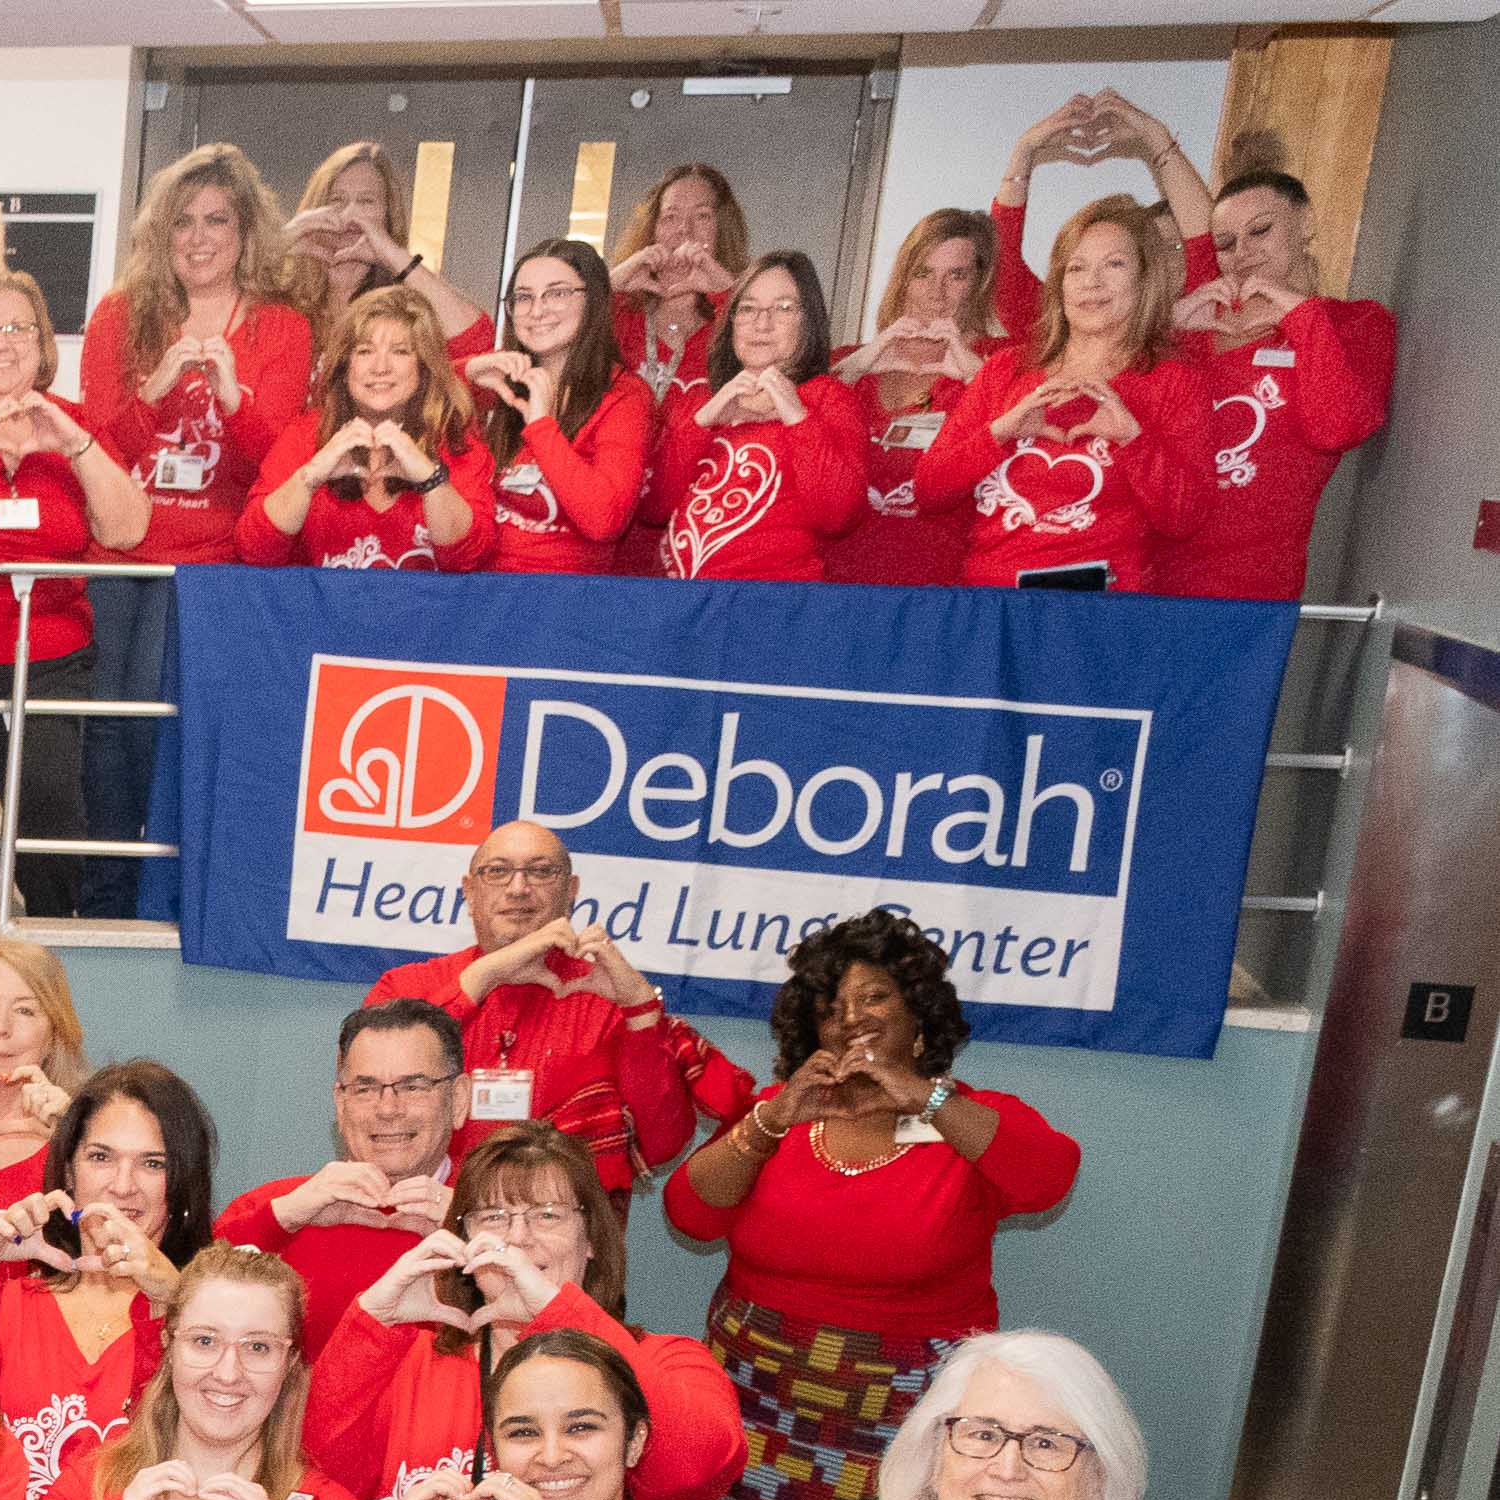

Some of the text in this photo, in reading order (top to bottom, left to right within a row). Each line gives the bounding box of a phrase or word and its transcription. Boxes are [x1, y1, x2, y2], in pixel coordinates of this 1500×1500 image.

[518, 699, 1097, 873] Deborah
[316, 857, 467, 926] Hear
[569, 881, 651, 943] nd
[1425, 992, 1450, 1023] B
